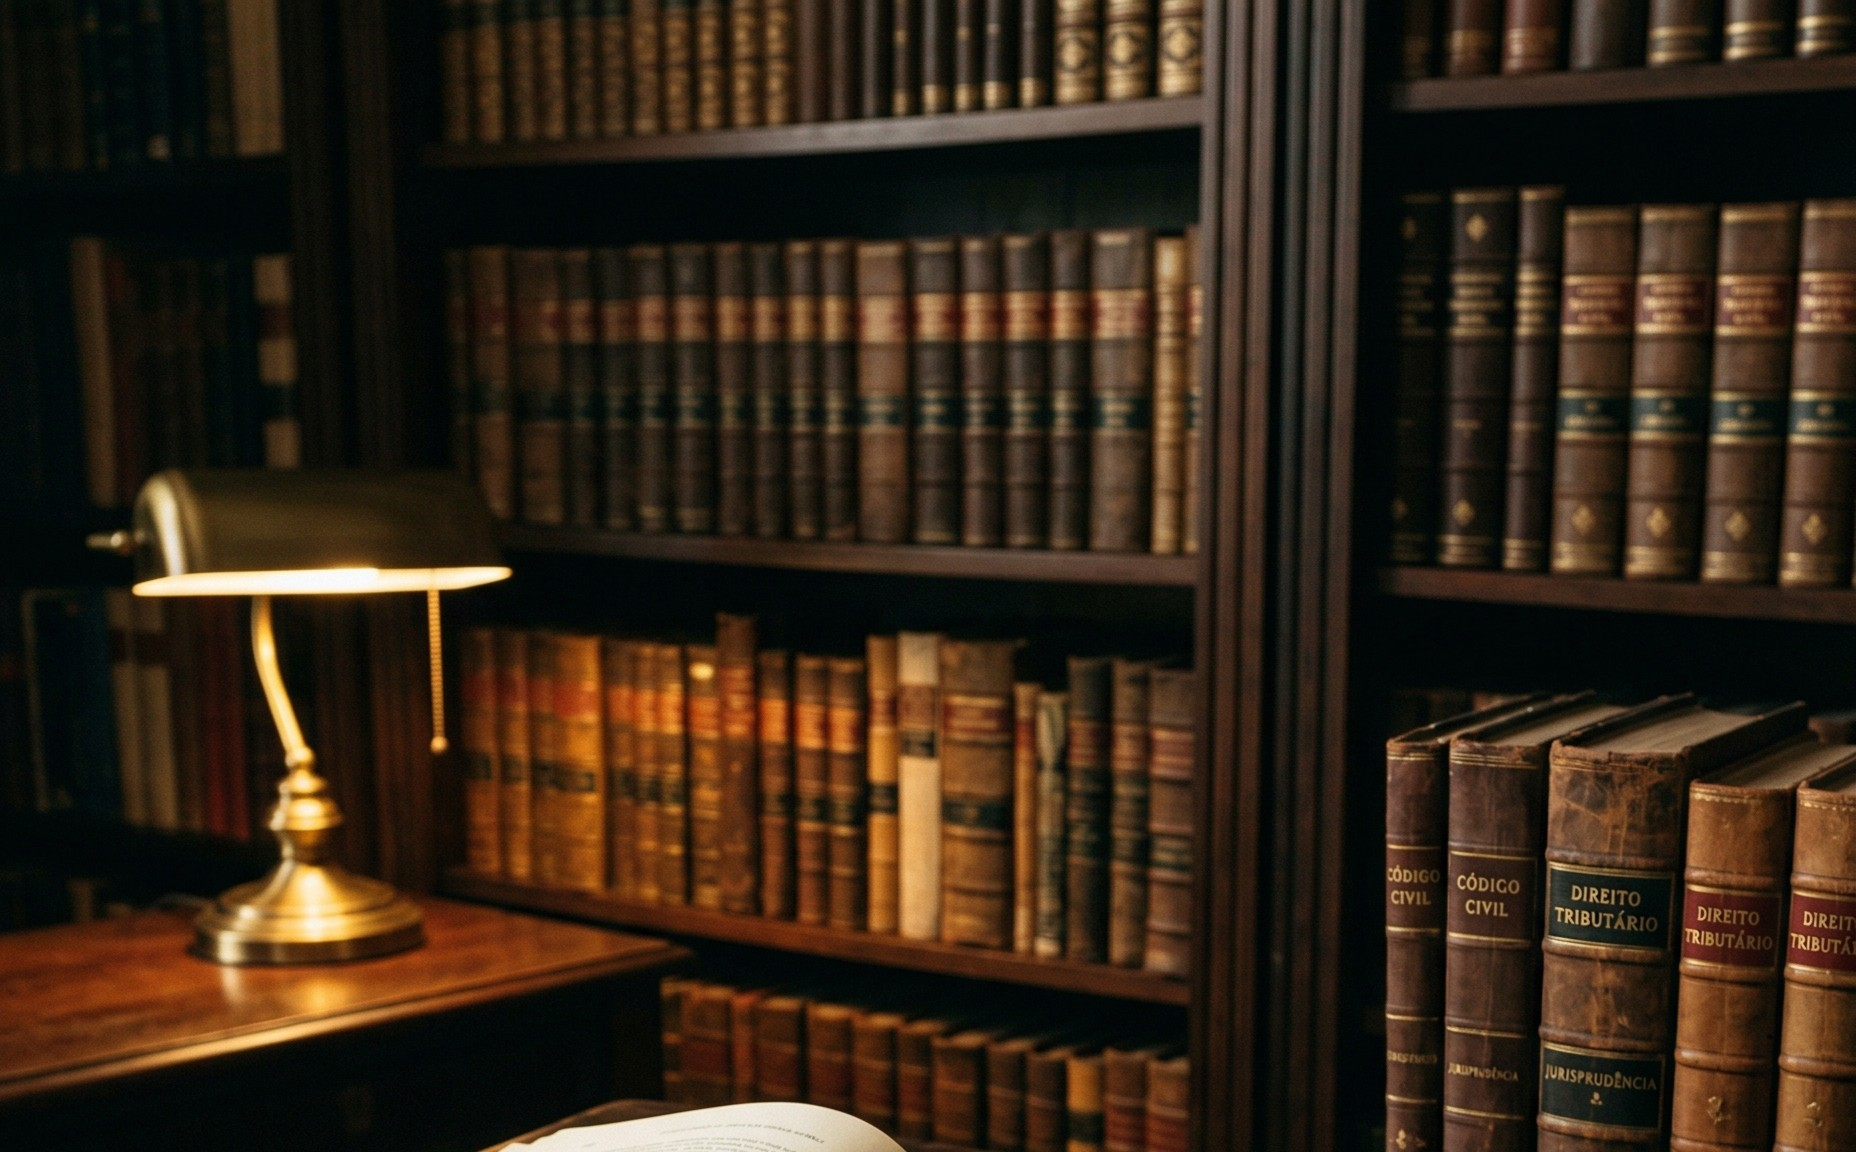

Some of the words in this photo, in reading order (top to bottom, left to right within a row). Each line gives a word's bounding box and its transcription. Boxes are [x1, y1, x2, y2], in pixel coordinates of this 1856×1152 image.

[1388, 865, 1440, 883] CÓDIGO
[1457, 872, 1520, 894] CÓDIGO
[1391, 890, 1431, 905] CIVIL
[1571, 884, 1641, 907] DIREITO
[1465, 899, 1509, 917] CIVIL
[1697, 906, 1760, 926] DIREITO
[1554, 906, 1658, 932] TRIBUTÁRIO
[1803, 911, 1856, 932] DIREIT
[1685, 928, 1773, 950] TRIBUTÁRIO
[1545, 1063, 1657, 1090] JURISPRUDÊNCIA
